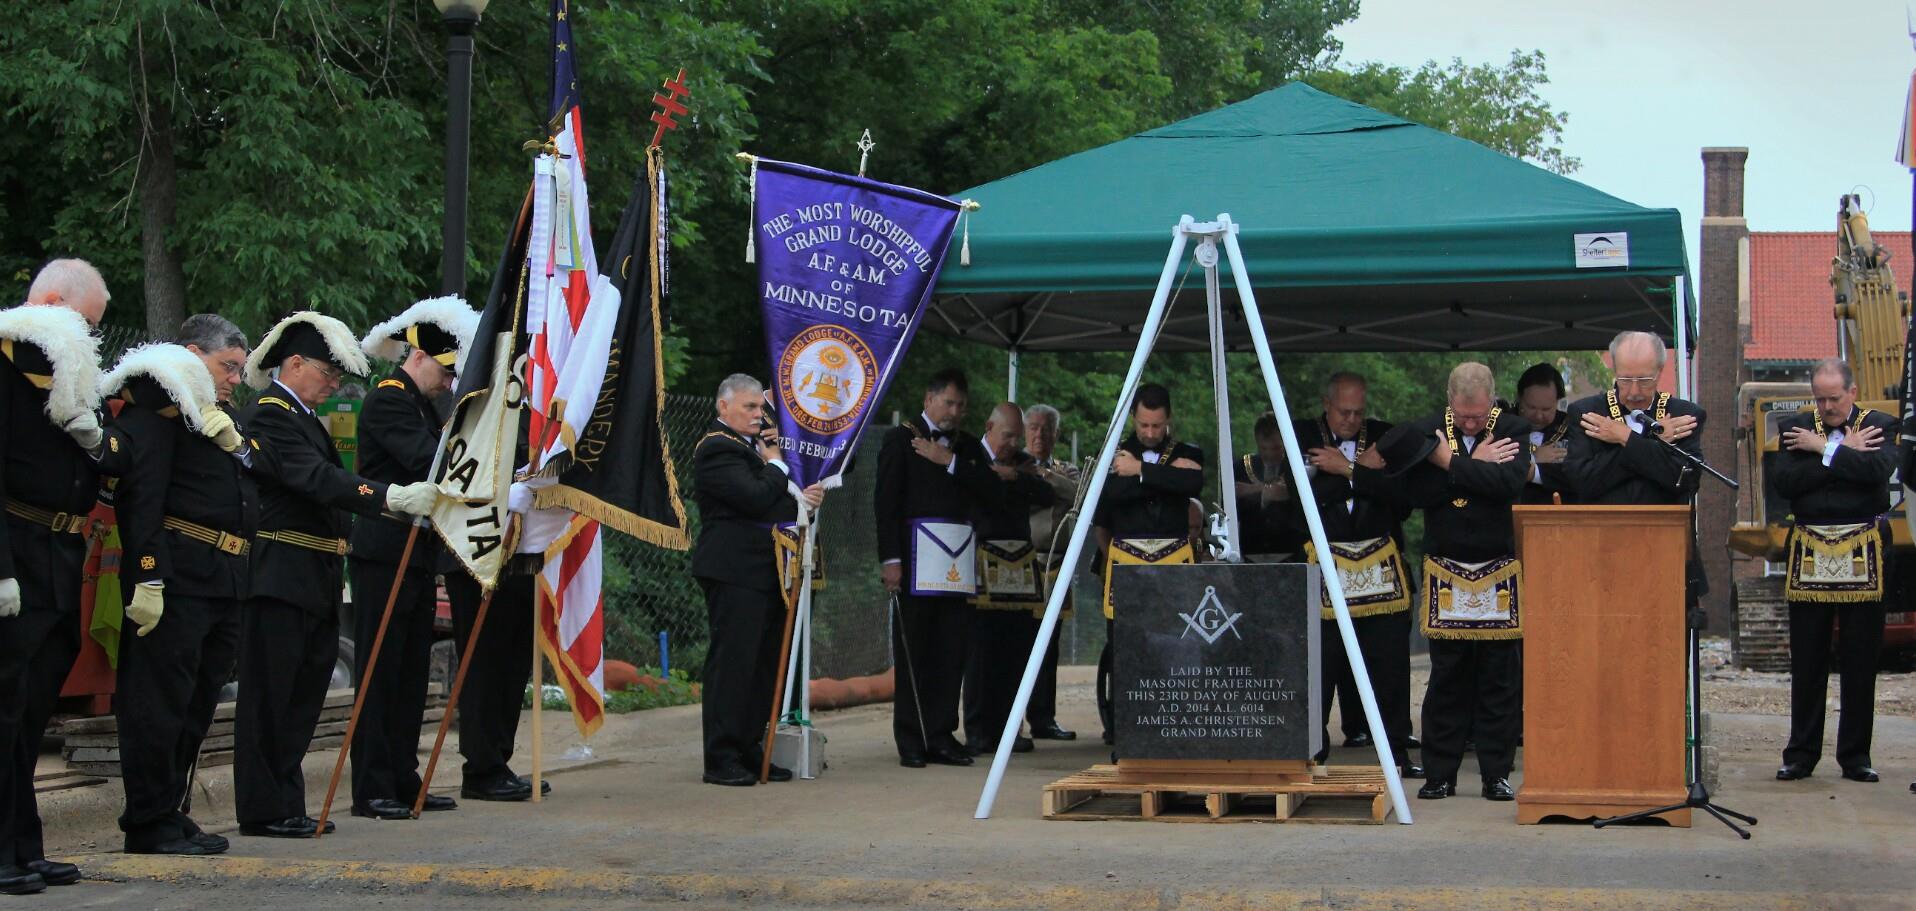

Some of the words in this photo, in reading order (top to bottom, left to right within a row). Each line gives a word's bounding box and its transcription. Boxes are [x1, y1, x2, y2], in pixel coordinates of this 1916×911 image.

[763, 213, 793, 239] THE
[797, 203, 843, 224] MOST
[850, 204, 933, 273] WORSHIPFUL
[784, 226, 842, 253] GRAND
[848, 227, 908, 276] LODGE
[807, 253, 835, 273] A.F.
[839, 262, 850, 277] &
[852, 265, 887, 286] A.M.
[831, 280, 854, 295] OF
[763, 282, 909, 328] MINNESOTA
[803, 329, 833, 343] LODGE
[1772, 400, 1817, 411] CATERPILLA
[1199, 608, 1220, 630] G
[1170, 666, 1200, 676] LAID
[1205, 666, 1222, 676] BY
[1227, 666, 1252, 676] THE
[1139, 679, 1200, 689] MASONIC
[1204, 679, 1285, 689] FRATERNITY
[1126, 691, 1155, 701] THIS
[1159, 691, 1189, 701] 23RD
[1194, 691, 1219, 701] DAY
[1223, 691, 1239, 701] OF
[1244, 691, 1296, 701] AUGUST
[1158, 704, 1182, 713] A.D.
[1186, 703, 1209, 713] 2014
[1214, 704, 1237, 713] A.L.
[1240, 703, 1264, 713] 6014
[1136, 716, 1176, 726] JAMES
[1181, 716, 1192, 725] A.
[1195, 716, 1285, 725] CHRISTENSEN
[1161, 728, 1206, 737] GRAND
[1211, 728, 1263, 737] MASTER
